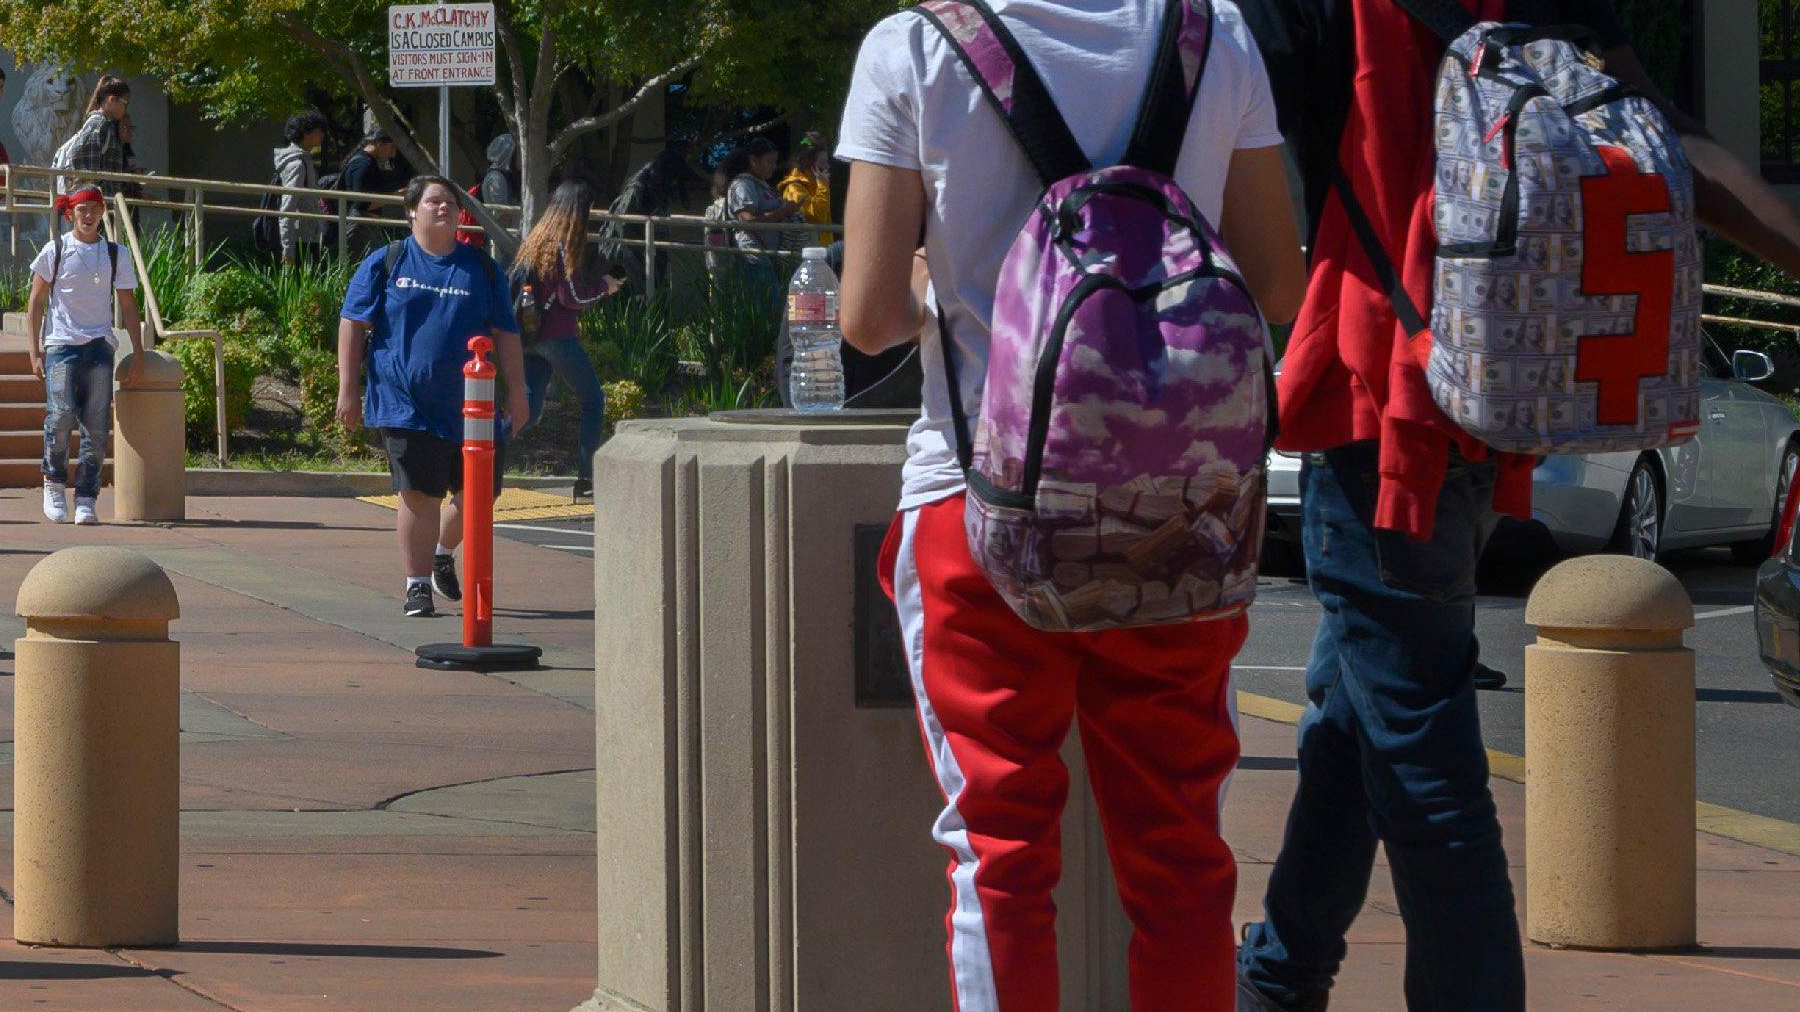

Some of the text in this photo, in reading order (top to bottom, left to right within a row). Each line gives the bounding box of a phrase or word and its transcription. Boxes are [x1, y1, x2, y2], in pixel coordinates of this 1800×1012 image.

[402, 31, 412, 49] A
[411, 30, 452, 49] CLOSED
[453, 30, 494, 48] CAMPUS
[392, 50, 493, 66] VISITORS MUST SIGN-IN
[392, 66, 493, 81] AT FRONT ENTRANCE
[395, 276, 471, 298] Champion
